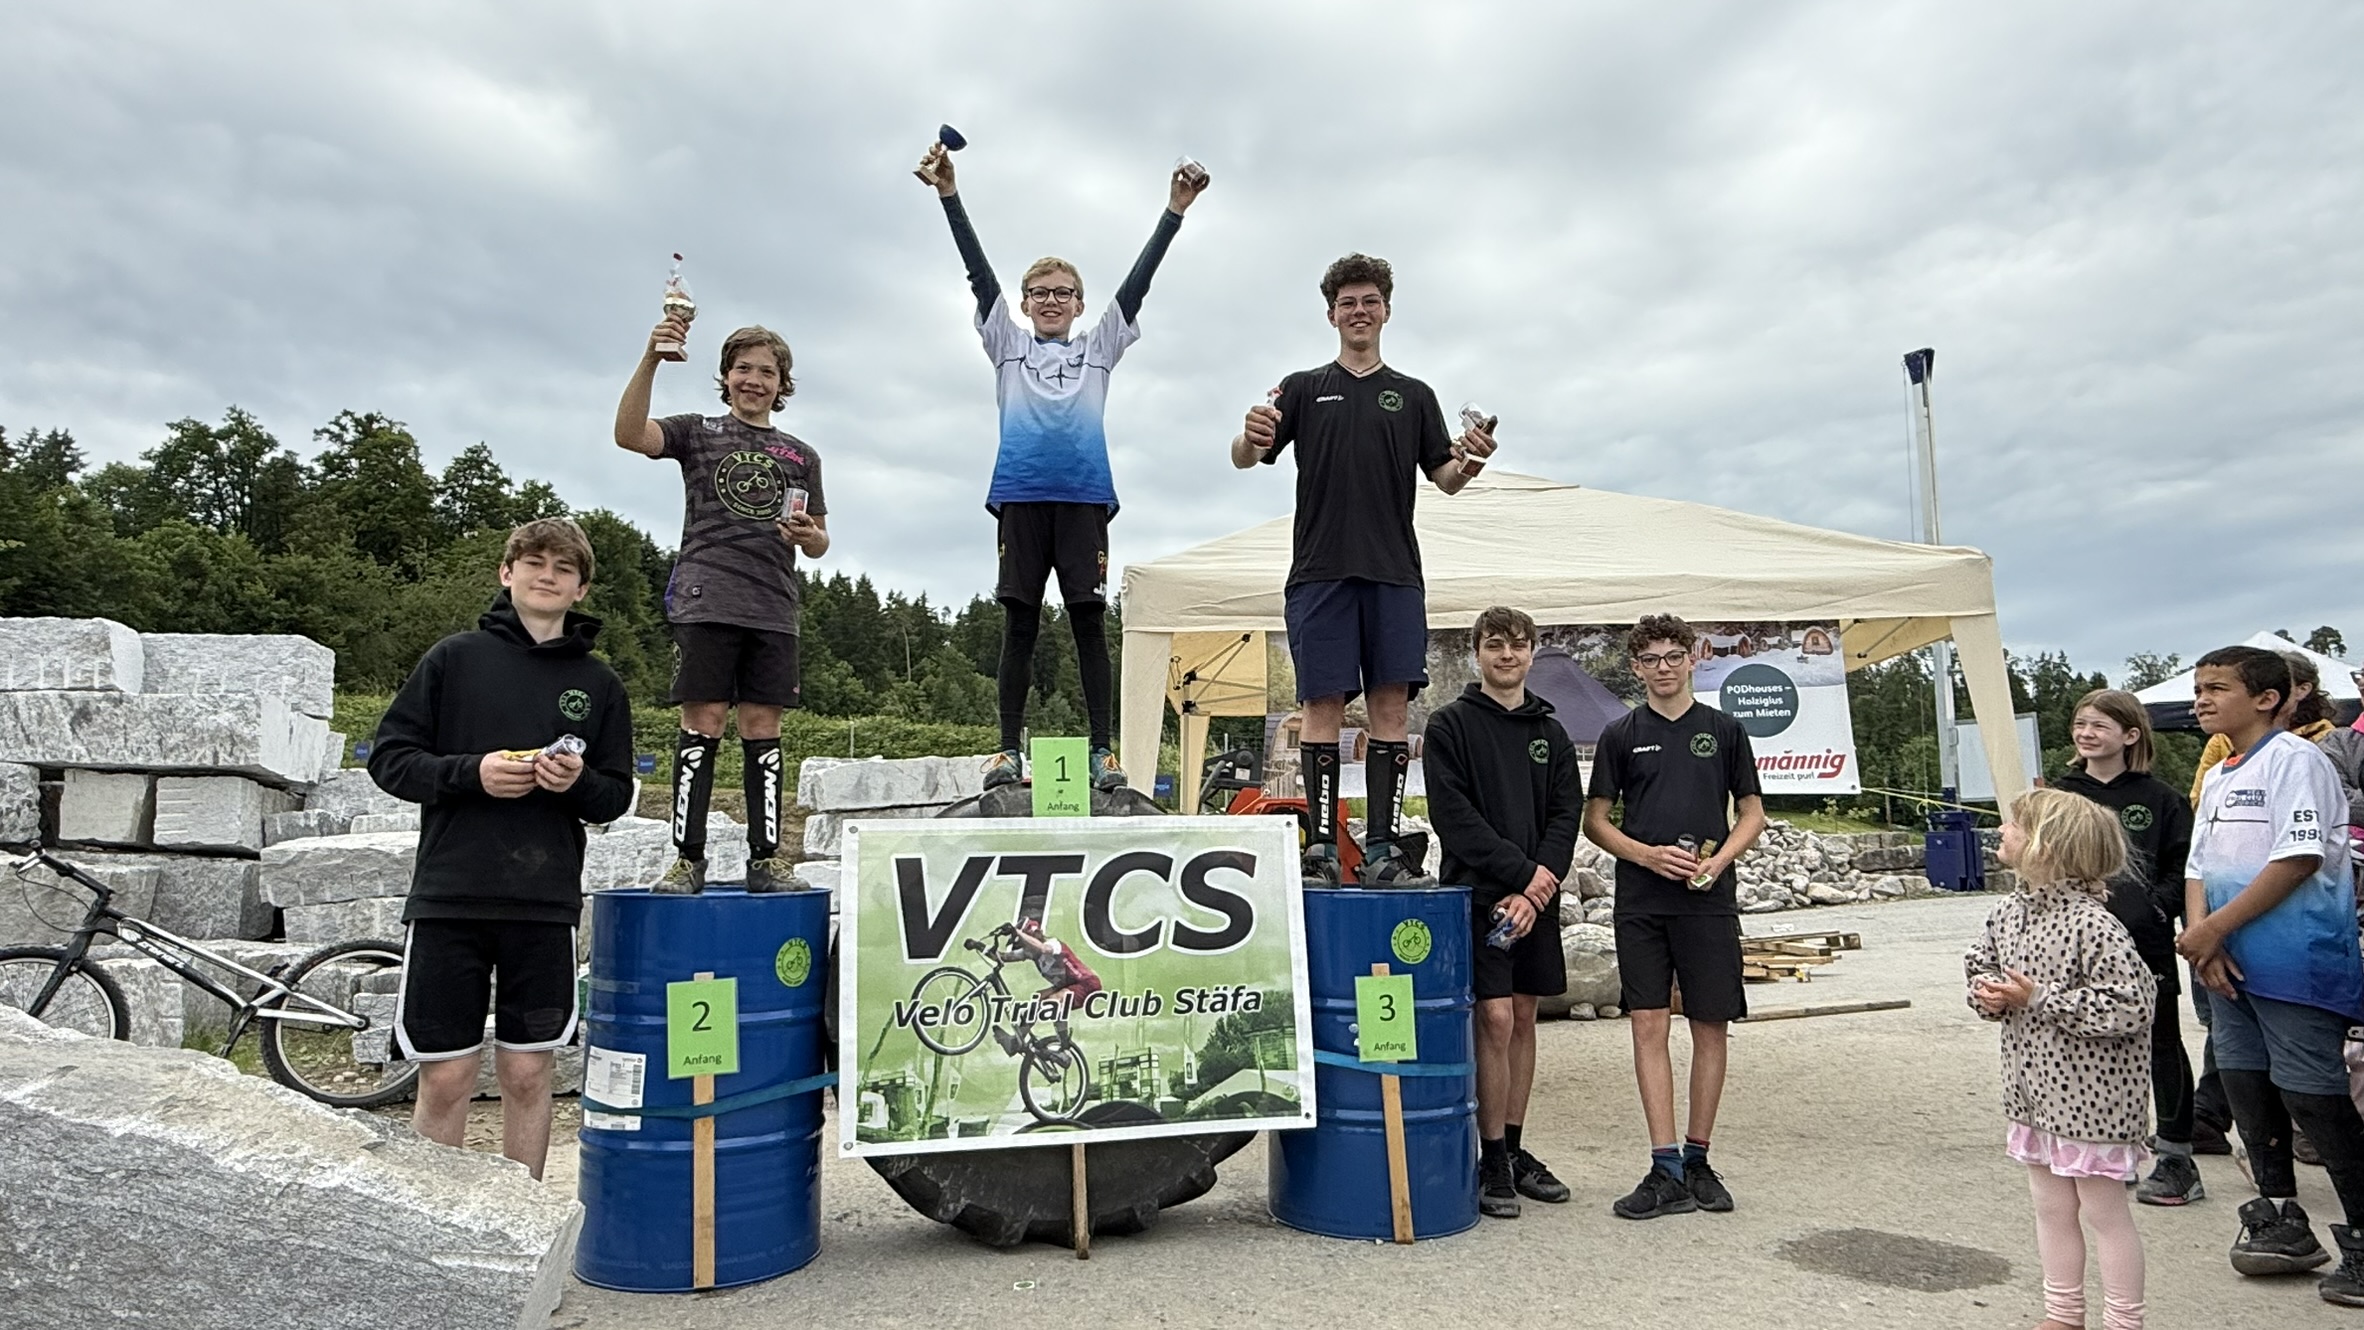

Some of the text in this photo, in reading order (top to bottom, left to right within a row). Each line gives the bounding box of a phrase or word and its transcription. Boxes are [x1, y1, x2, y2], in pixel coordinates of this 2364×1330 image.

[732, 452, 775, 469] VTCS
[1726, 684, 1783, 695] PODhouses
[1737, 695, 1784, 707] Holziglus
[1732, 708, 1791, 718] zum Mieten
[1054, 755, 1071, 782] 1
[1763, 772, 1796, 781] Freizeit
[675, 764, 694, 842] CLEAN
[764, 769, 777, 844] CLEAN
[1047, 801, 1080, 812] Anfang
[1319, 774, 1330, 835] hebo
[893, 849, 1259, 961] VTCS
[692, 1001, 712, 1032] 2
[895, 985, 1262, 1028] Velo Trial Club Stäfa
[1379, 994, 1396, 1022] 3
[1374, 1041, 1406, 1053] Anfang
[683, 1054, 722, 1067] Anfang
